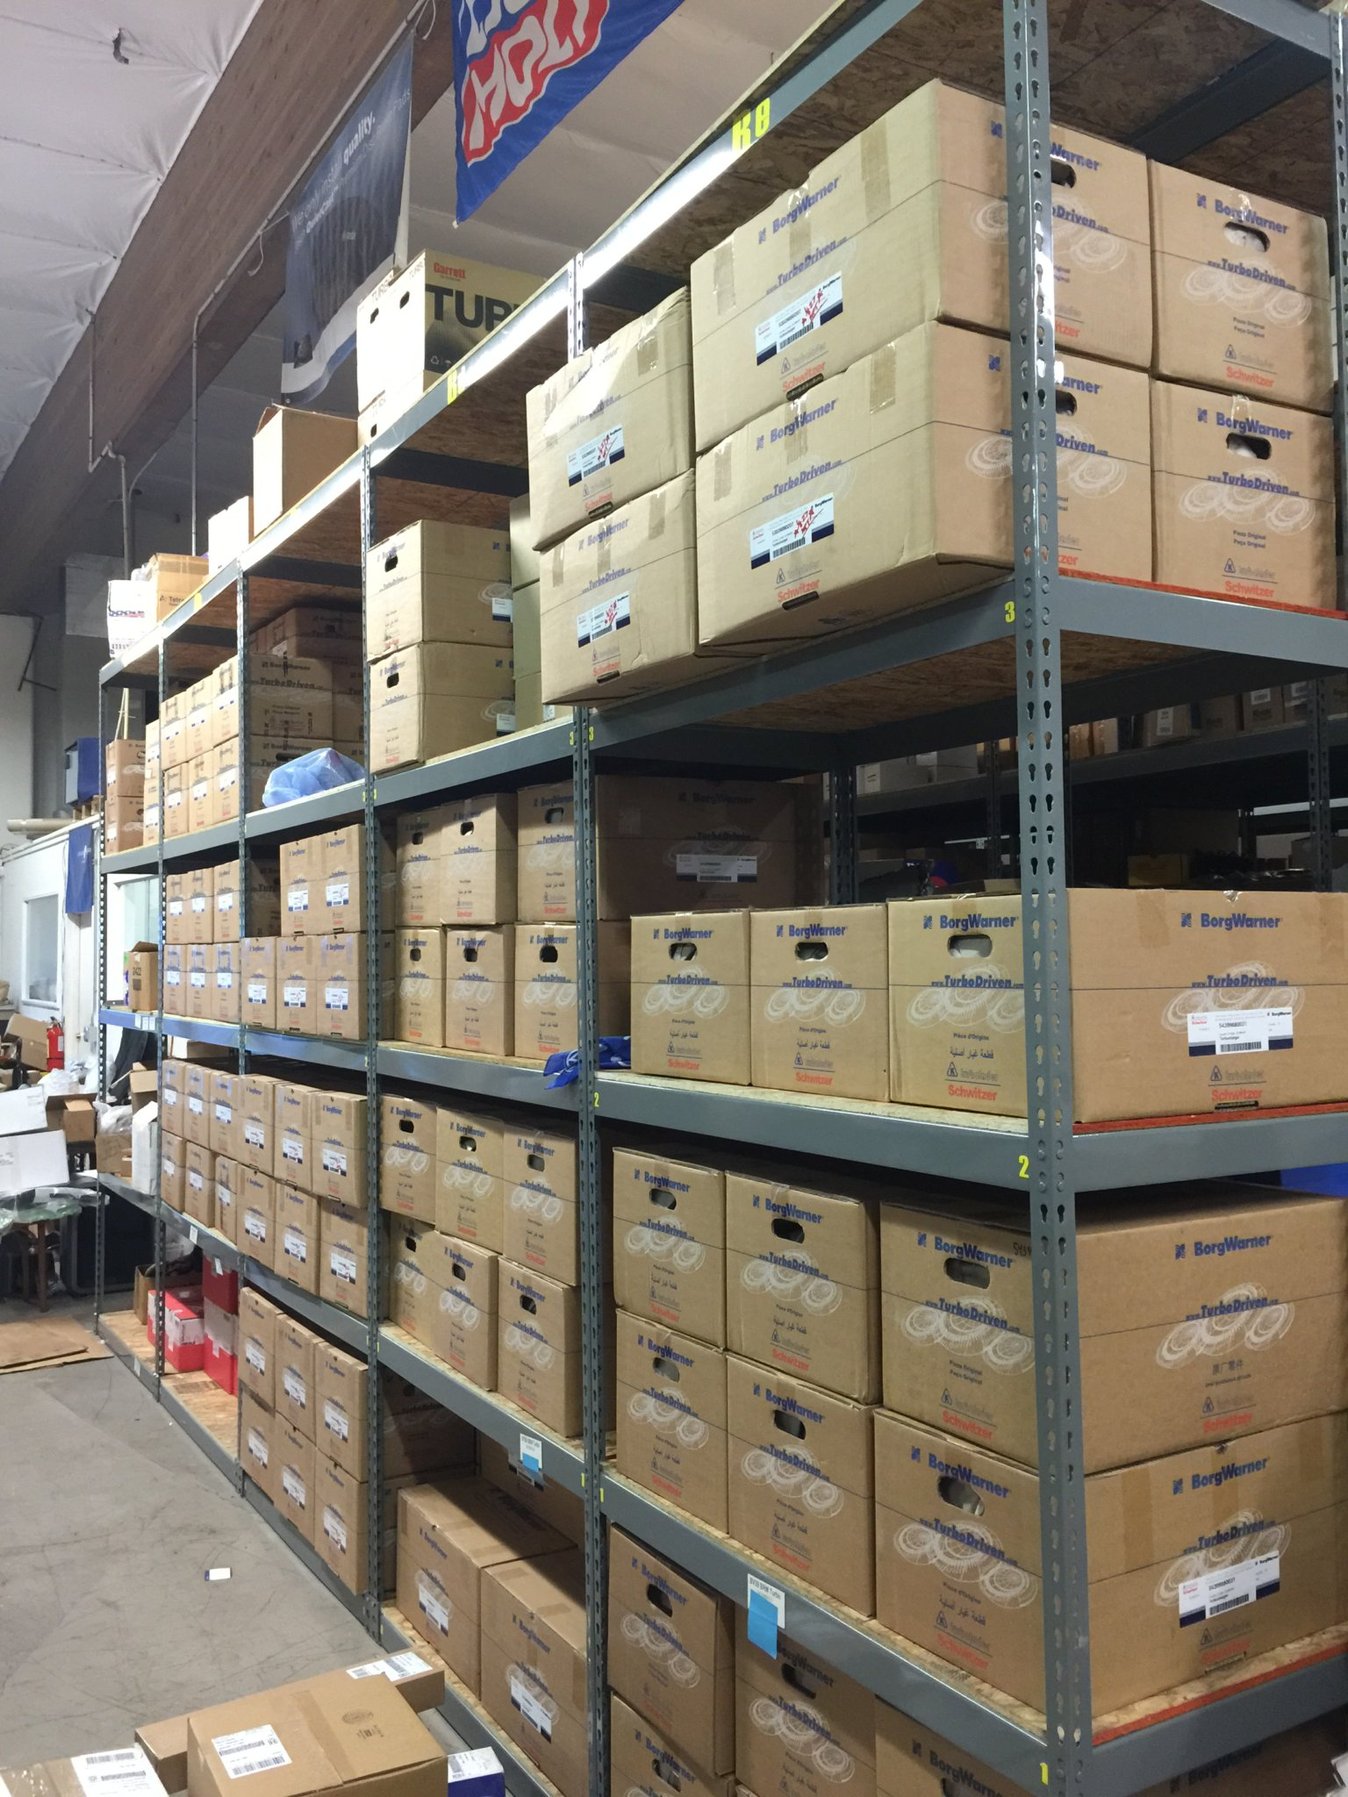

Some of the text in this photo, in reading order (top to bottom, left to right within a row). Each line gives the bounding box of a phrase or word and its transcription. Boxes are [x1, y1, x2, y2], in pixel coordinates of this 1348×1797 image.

[1052, 142, 1101, 172] Warner
[772, 175, 840, 235] BorgWarner
[1214, 198, 1289, 235] BorgWarner
[433, 261, 466, 280] Garrett
[425, 283, 522, 333] TUR
[782, 360, 827, 392] Schwitzer
[1225, 365, 1275, 389] Schwitzer
[769, 399, 837, 444] BorgWarner
[1215, 411, 1293, 440] BorgWarner
[777, 578, 821, 602] Schwitzer
[1224, 580, 1275, 598] Schwitzer
[1005, 601, 1015, 623] 3
[788, 923, 848, 938] BorgWarner
[940, 913, 1019, 932] BorgWarner
[1201, 913, 1281, 931] BorgWarner
[663, 927, 714, 942] BorgWarner
[795, 1071, 834, 1086] Schwitzer
[593, 1091, 600, 1108] 2
[947, 1083, 999, 1102] Schwitzer
[1210, 1087, 1264, 1102] Schwitzer
[1018, 1154, 1030, 1179] 2
[644, 1171, 691, 1194] BorgWarner
[765, 1197, 823, 1225] BorgWarner
[934, 1235, 1014, 1270] BorgWarner
[1193, 1234, 1272, 1257] BorgWarner
[647, 1337, 695, 1369] BorgWarner
[765, 1387, 824, 1424] BorgWarner
[928, 1452, 1010, 1499] BorgWarner
[1191, 1457, 1269, 1491] BorgWarner
[929, 1750, 1002, 1797] BorgWarn
[1040, 1762, 1048, 1786] 1
